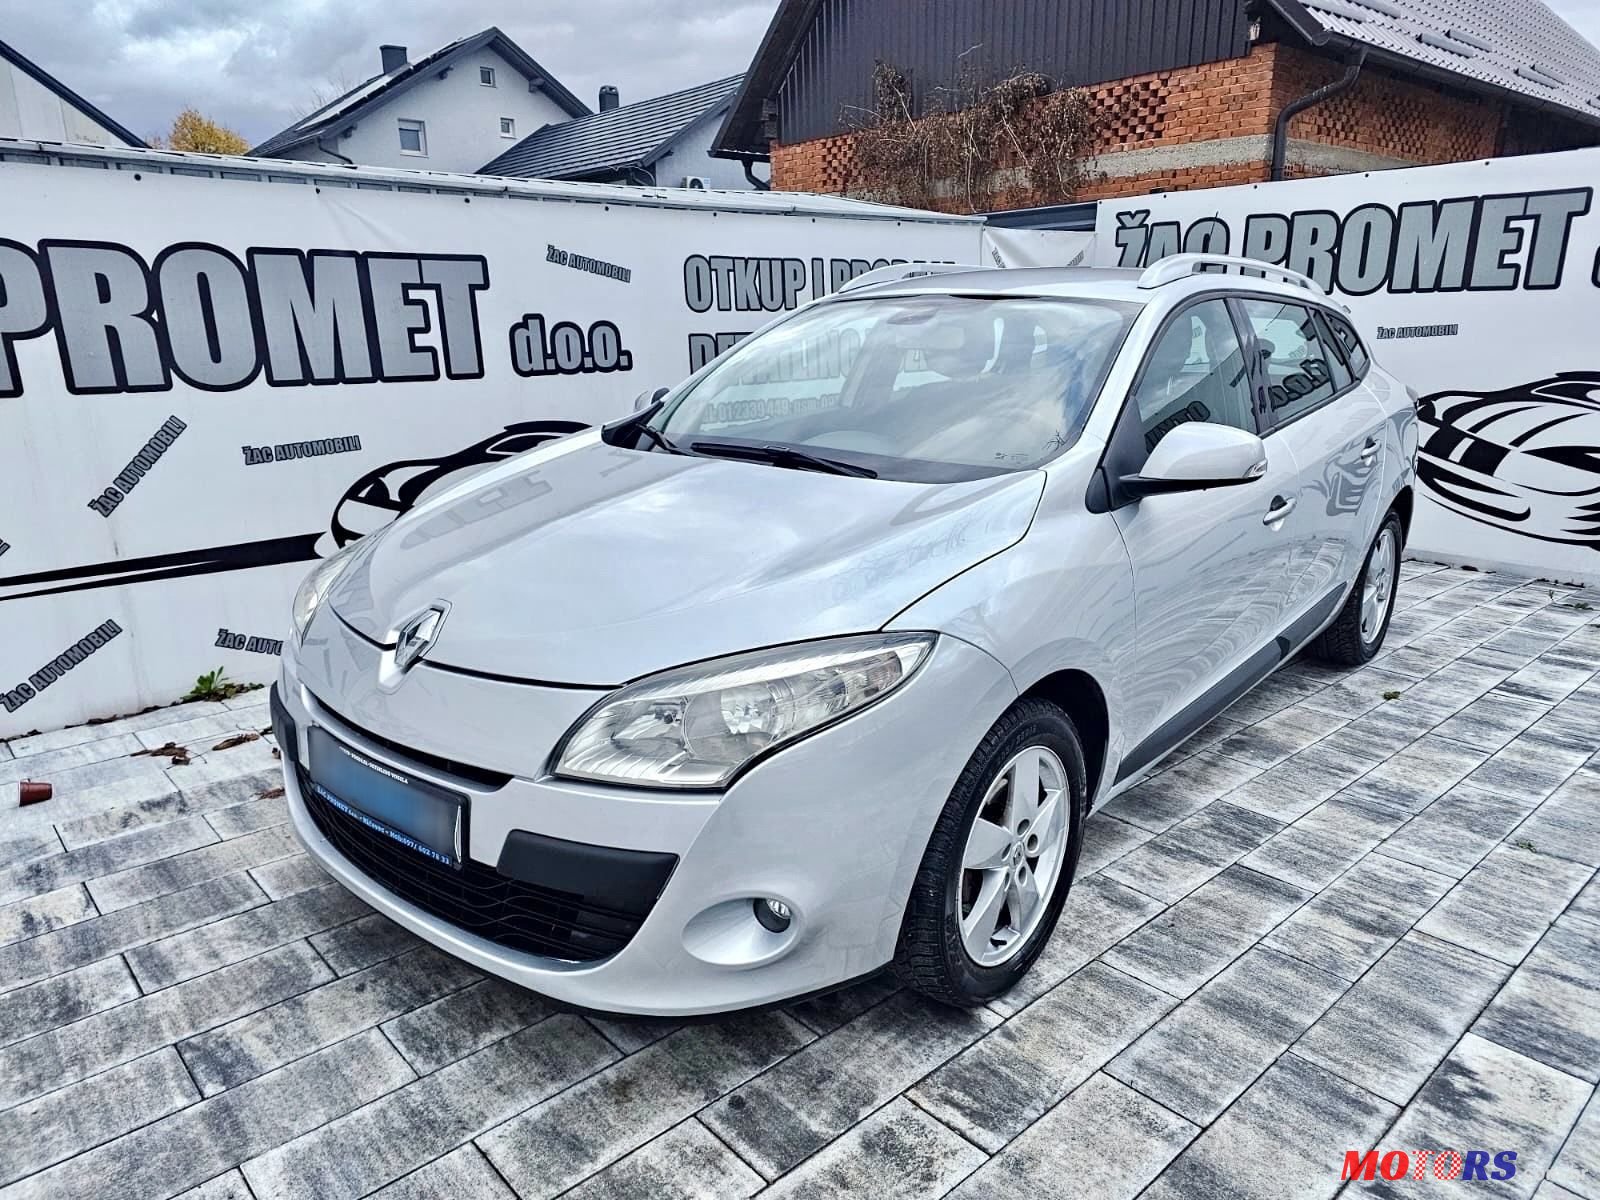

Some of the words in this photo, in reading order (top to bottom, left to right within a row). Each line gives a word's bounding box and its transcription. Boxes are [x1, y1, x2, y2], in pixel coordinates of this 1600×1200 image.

[546, 244, 568, 266] ŽAC
[568, 253, 631, 283] AUTOMOBILI
[1240, 187, 1593, 295] PROMET
[684, 255, 806, 312] OTKUP
[811, 258, 824, 300] I
[0, 238, 489, 398] PROMET
[509, 313, 633, 377] d.o.o.
[1377, 326, 1395, 339] ŽAC
[1396, 324, 1458, 338] AUTOMOBILI
[87, 487, 124, 518] ŽAC
[113, 415, 187, 493] AUTOMOBILI
[241, 446, 273, 466] ŽAC
[275, 435, 362, 462] AUTOMOBILI
[0, 682, 37, 713] ŽAC
[28, 619, 123, 693] AUTOMOBILI
[215, 628, 246, 651] ŽAC
